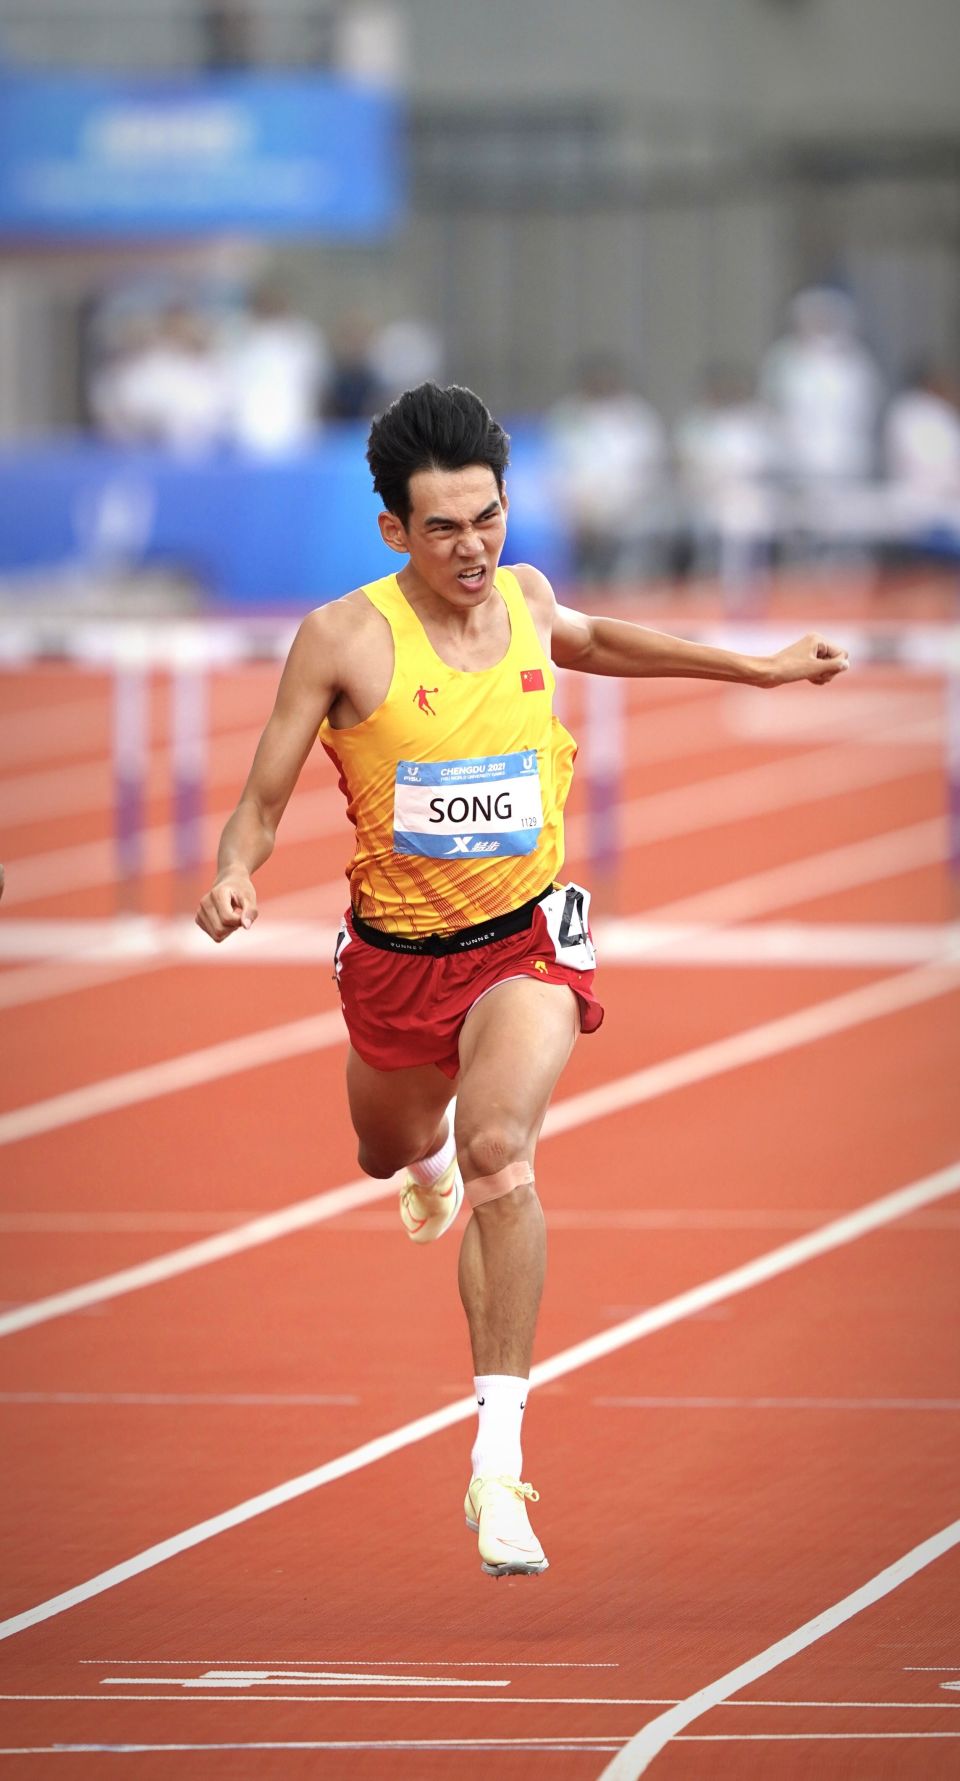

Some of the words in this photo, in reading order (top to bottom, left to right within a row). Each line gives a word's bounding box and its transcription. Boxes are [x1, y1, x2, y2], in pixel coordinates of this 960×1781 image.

[440, 765, 486, 776] CHENGDU
[487, 762, 506, 772] 2021
[429, 792, 512, 823] SONG
[521, 817, 537, 827] 1129
[558, 886, 594, 961] 4
